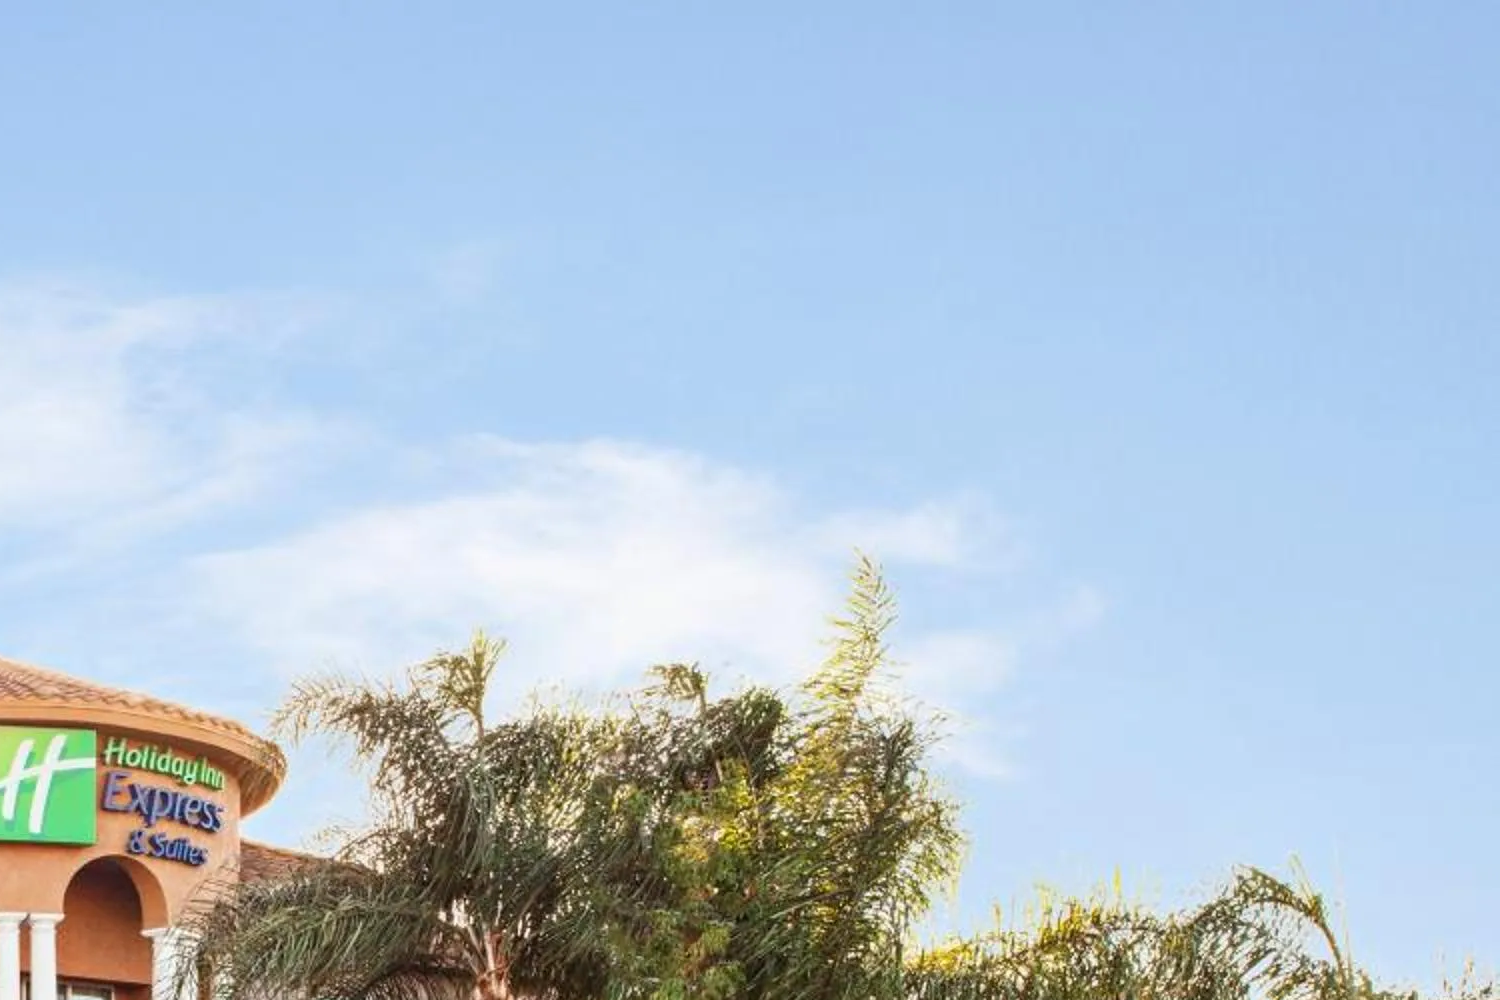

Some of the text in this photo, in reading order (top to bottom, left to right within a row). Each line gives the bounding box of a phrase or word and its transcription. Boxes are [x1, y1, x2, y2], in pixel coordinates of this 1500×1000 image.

[104, 737, 226, 793] Holiday Inn
[102, 770, 225, 833] Express
[127, 830, 208, 866] & Suites
